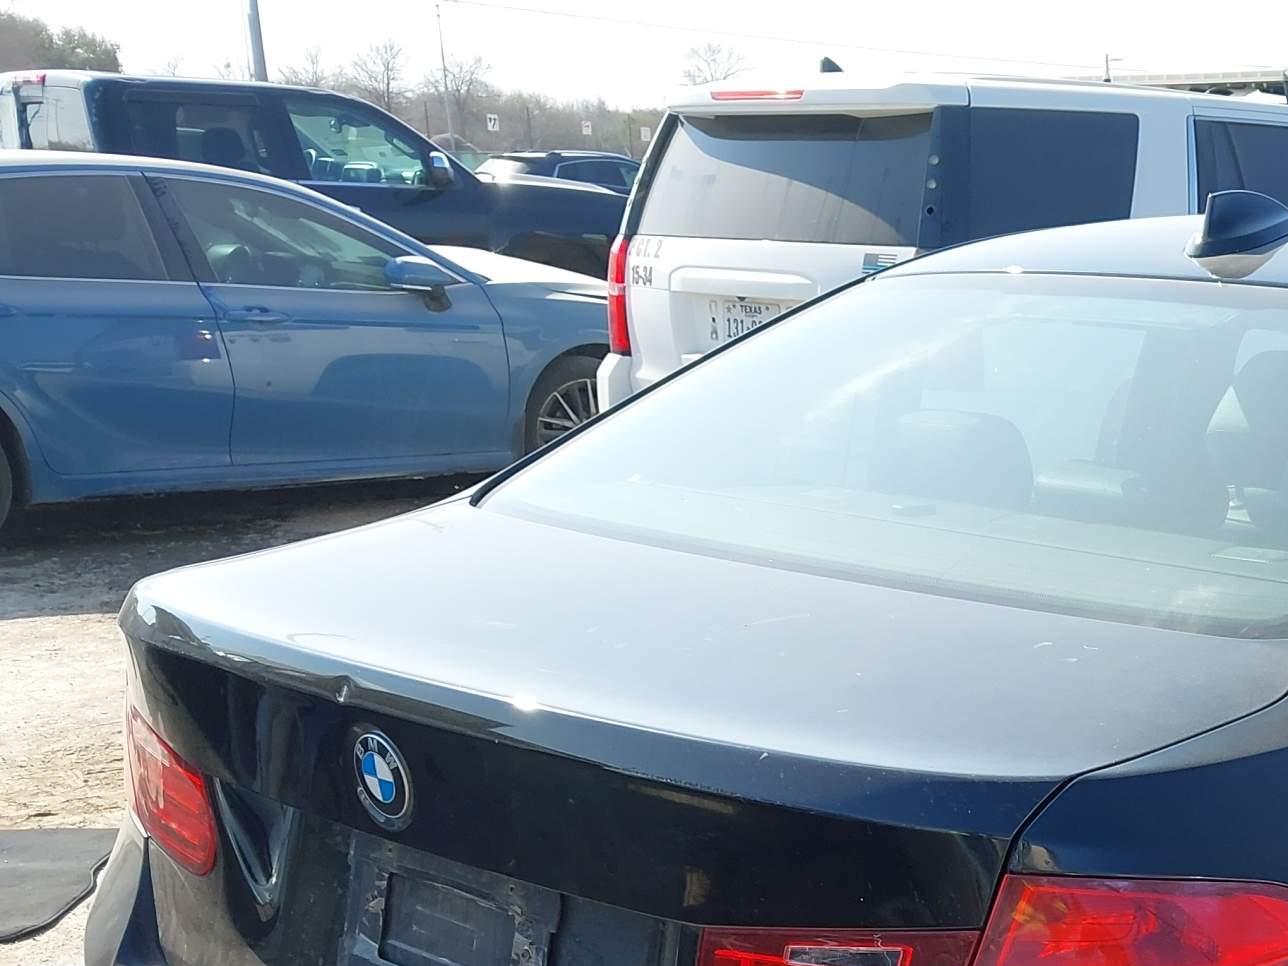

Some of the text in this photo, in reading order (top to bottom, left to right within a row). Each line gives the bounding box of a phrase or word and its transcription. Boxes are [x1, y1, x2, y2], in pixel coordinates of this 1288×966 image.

[653, 239, 664, 259] 2
[631, 265, 653, 287] 15-34
[739, 304, 762, 315] TEXAS
[355, 737, 399, 771] BMW
